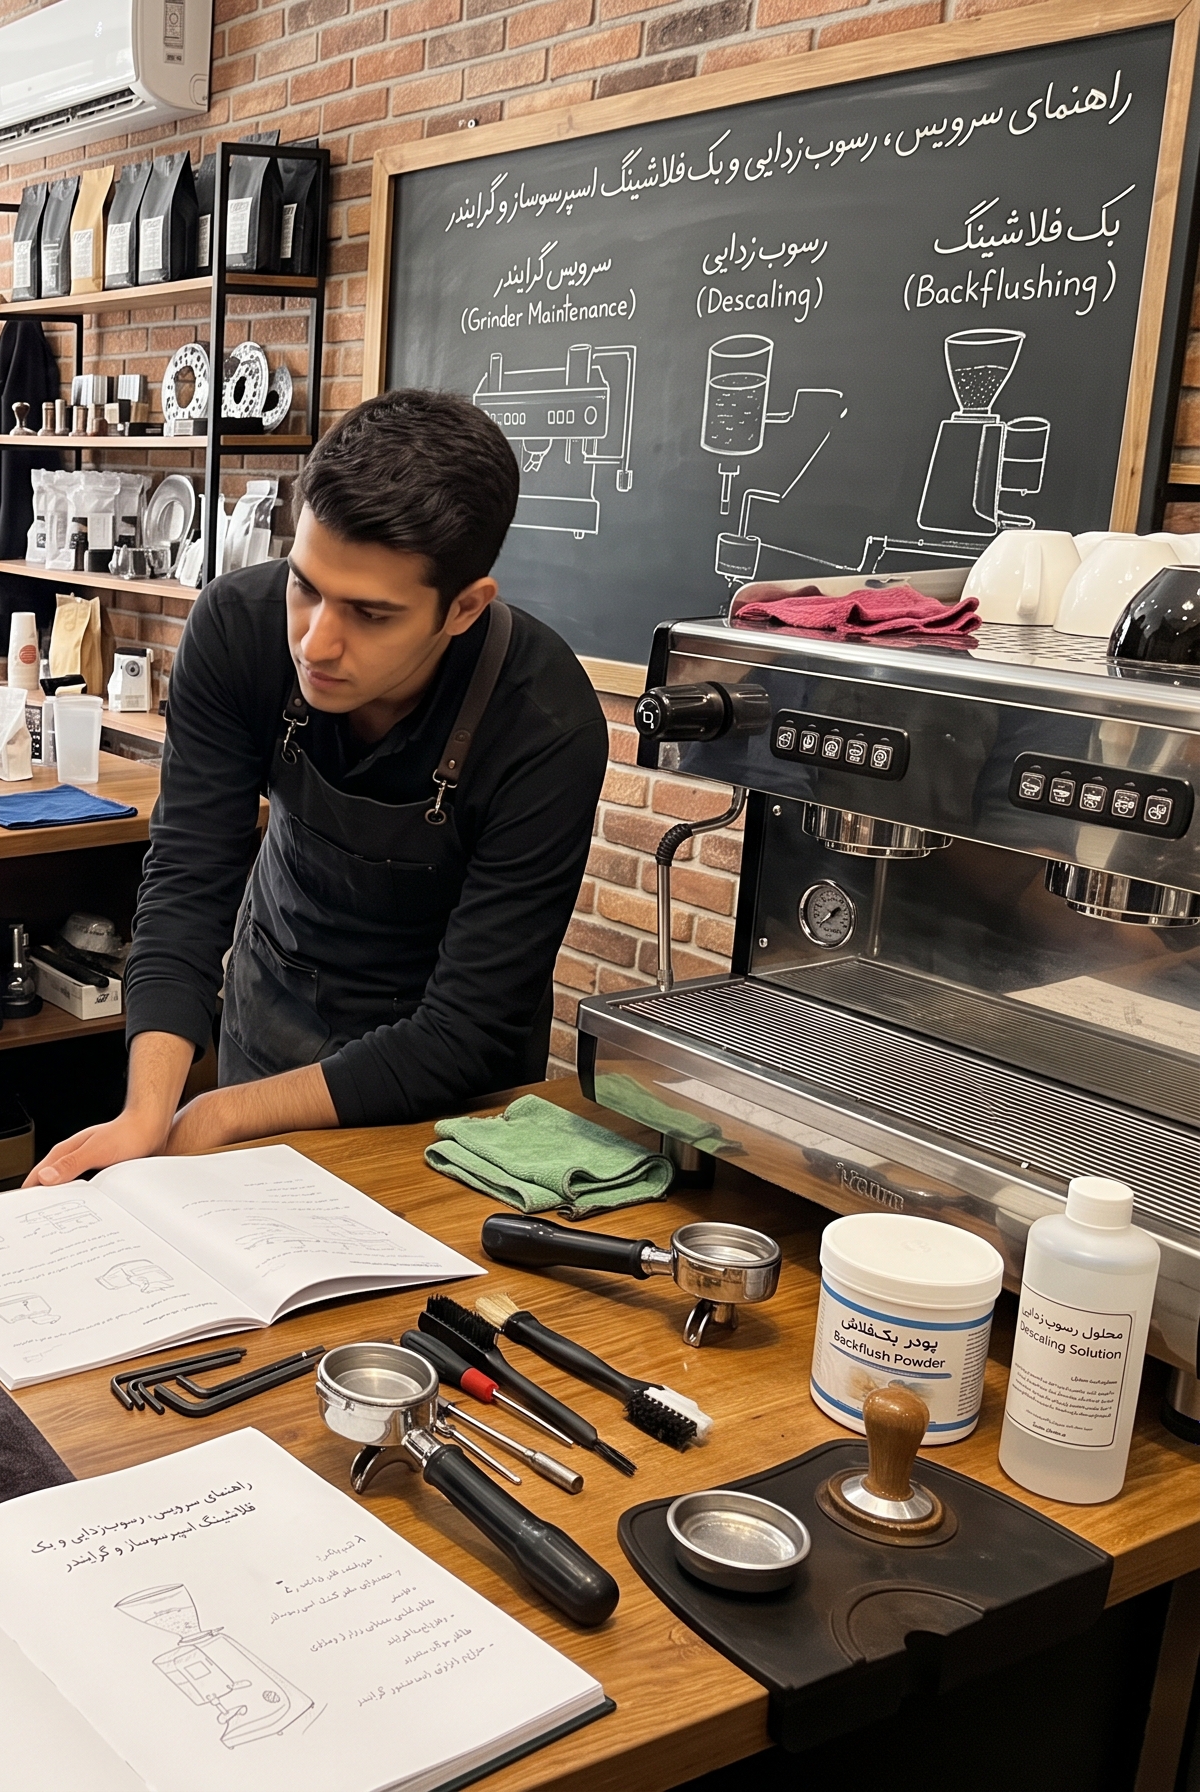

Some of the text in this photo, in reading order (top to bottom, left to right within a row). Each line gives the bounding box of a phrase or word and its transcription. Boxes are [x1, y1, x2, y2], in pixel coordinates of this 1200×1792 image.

[1008, 69, 1133, 136] راهنمای
[883, 106, 1004, 157] سرویس،
[724, 157, 740, 185] و
[444, 171, 509, 233] گرایندر
[495, 200, 508, 225] و
[507, 166, 598, 224] اسپرسوساز
[492, 239, 613, 298] سرویس گرایندر
[902, 259, 1117, 317] (Backflushing)
[460, 287, 637, 335] (Grinder Maintenance)
[695, 276, 824, 324] (Descaling)
[832, 1329, 947, 1369] Backflush Powder
[903, 1337, 939, 1355] پودر
[1019, 1319, 1123, 1361] Descaling Solution
[1081, 1326, 1124, 1341] محلول
[203, 1480, 253, 1504] راهنمای
[30, 1540, 57, 1554] بک
[58, 1538, 67, 1549] و
[66, 1544, 110, 1573] گرایندر
[114, 1546, 124, 1557] و
